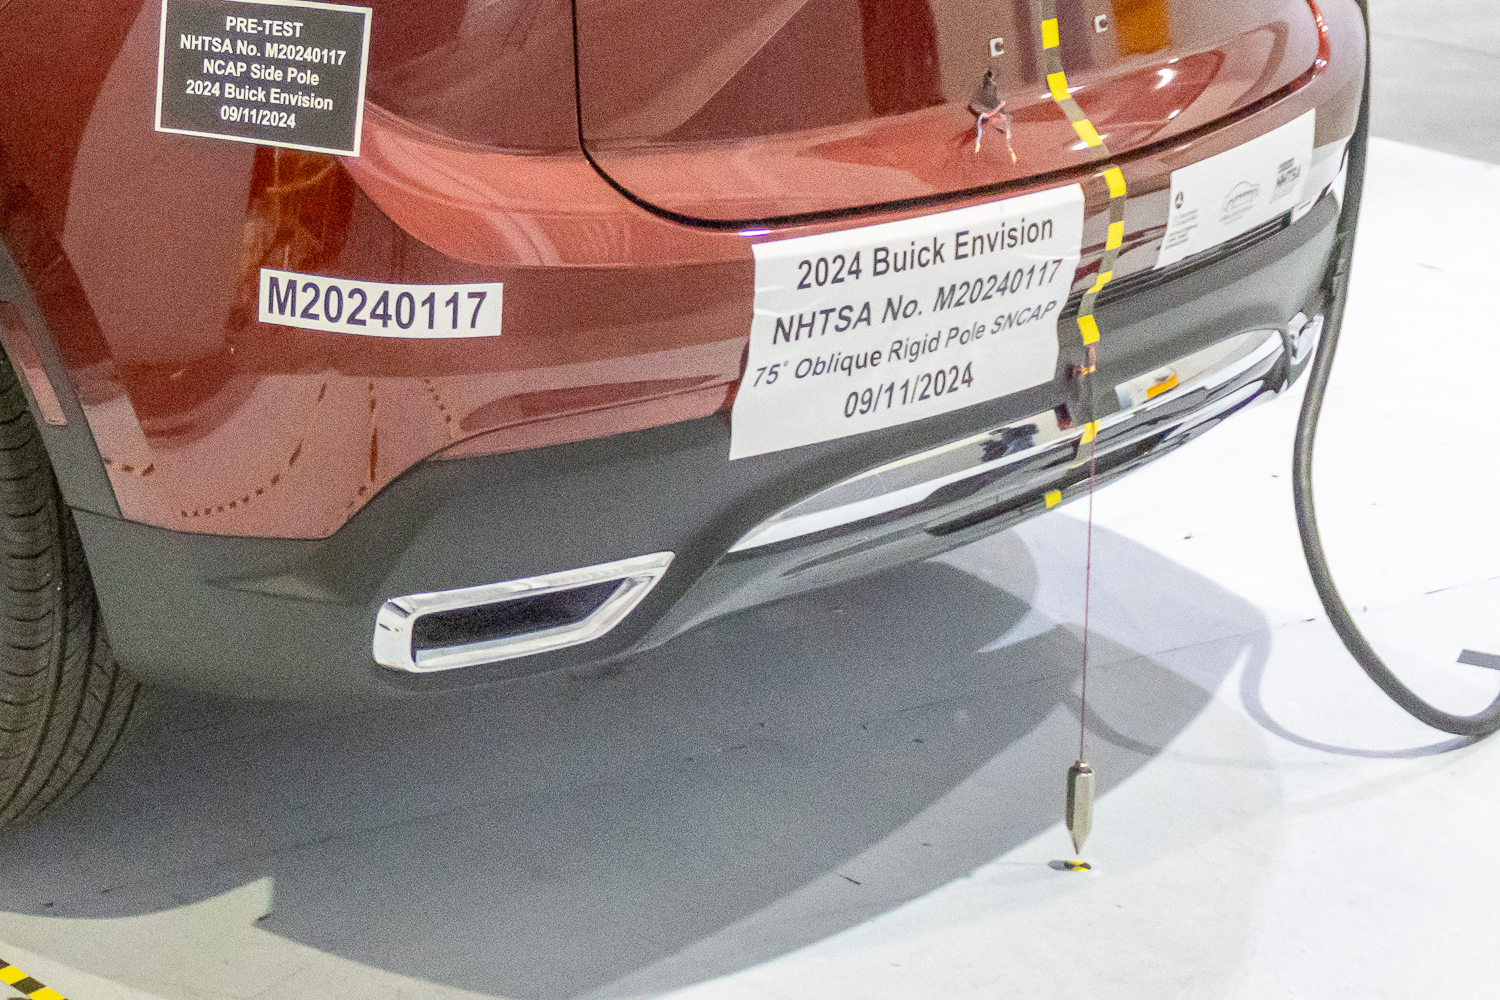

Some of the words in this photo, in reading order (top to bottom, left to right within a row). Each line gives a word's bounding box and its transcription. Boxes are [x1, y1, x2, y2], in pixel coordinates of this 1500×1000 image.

[226, 16, 304, 38] PRE-TEST
[180, 34, 233, 54] NHTSA
[236, 40, 261, 57] No.
[265, 42, 347, 65] M20240117
[203, 59, 247, 77] NCAP
[250, 64, 283, 81] Side
[287, 67, 320, 86] Pole
[186, 79, 220, 97] 2024
[224, 83, 267, 102] Buick
[270, 88, 334, 110] Envision
[220, 105, 296, 128] 09/11/2024
[797, 251, 862, 290] 2024
[872, 236, 946, 277] Buick
[954, 218, 1054, 260] Envision
[268, 276, 488, 330] M20240117
[772, 302, 872, 345] NHTSA
[881, 295, 923, 323] No.
[932, 258, 1064, 312] M20240117
[795, 350, 882, 379] Oblique
[887, 331, 941, 363] Rigid
[945, 321, 986, 349] Pole
[990, 300, 1058, 335] SNCAP
[844, 361, 975, 418] 09/11/2024
